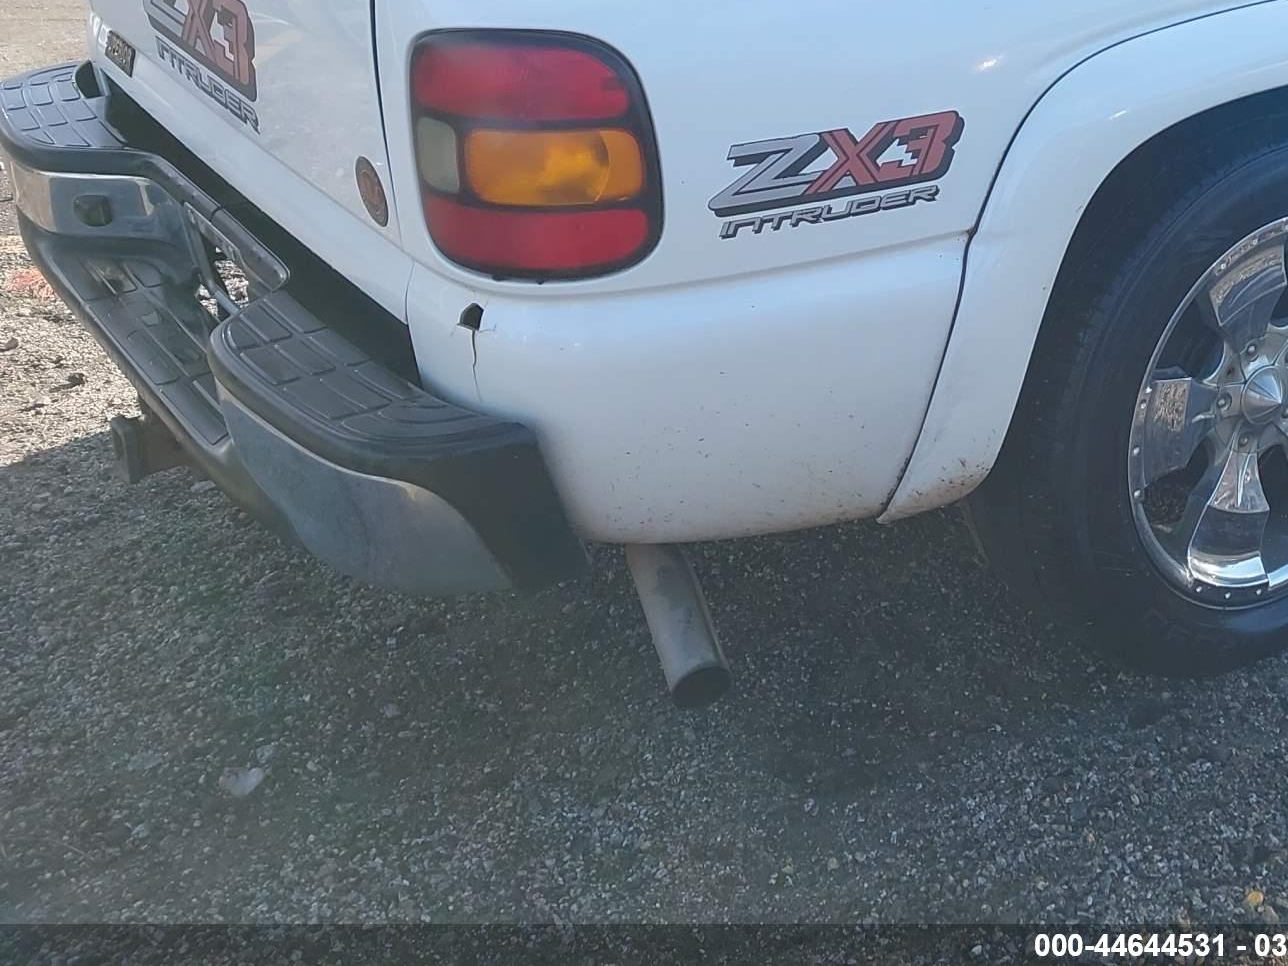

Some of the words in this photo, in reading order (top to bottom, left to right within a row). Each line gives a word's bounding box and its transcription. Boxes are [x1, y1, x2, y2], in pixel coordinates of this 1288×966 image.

[155, 35, 261, 135] INTRUDER
[708, 110, 965, 217] ZX3
[719, 185, 941, 240] INTRUDER
